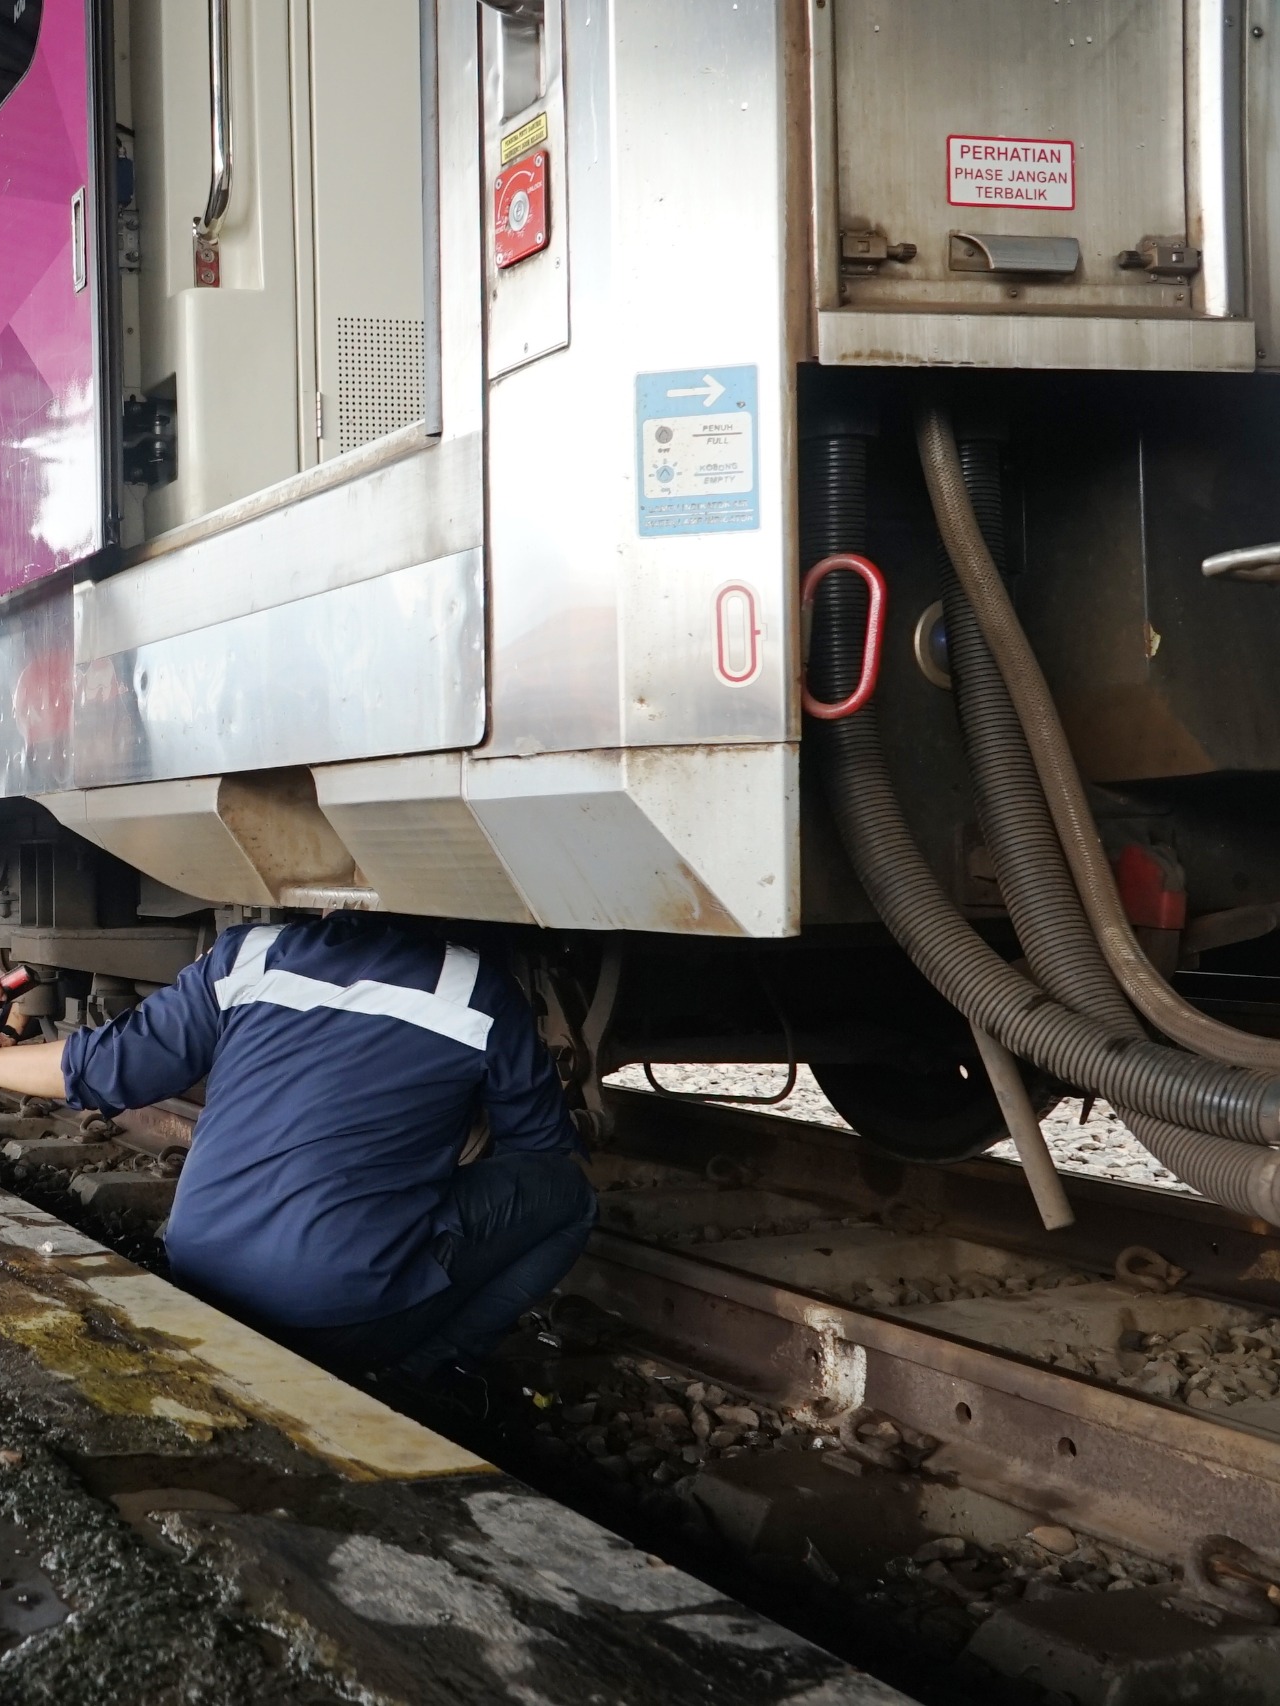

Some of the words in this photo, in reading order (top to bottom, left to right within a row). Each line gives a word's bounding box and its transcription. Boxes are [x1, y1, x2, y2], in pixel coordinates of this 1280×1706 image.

[960, 144, 1062, 164] PERHATIAN
[954, 167, 1004, 182] PHASE
[1008, 170, 1068, 184] JANGAN
[975, 186, 1048, 201] TERBALIK
[702, 424, 733, 432] PENUH
[707, 437, 729, 445] FULL
[703, 475, 736, 485] EMPTY
